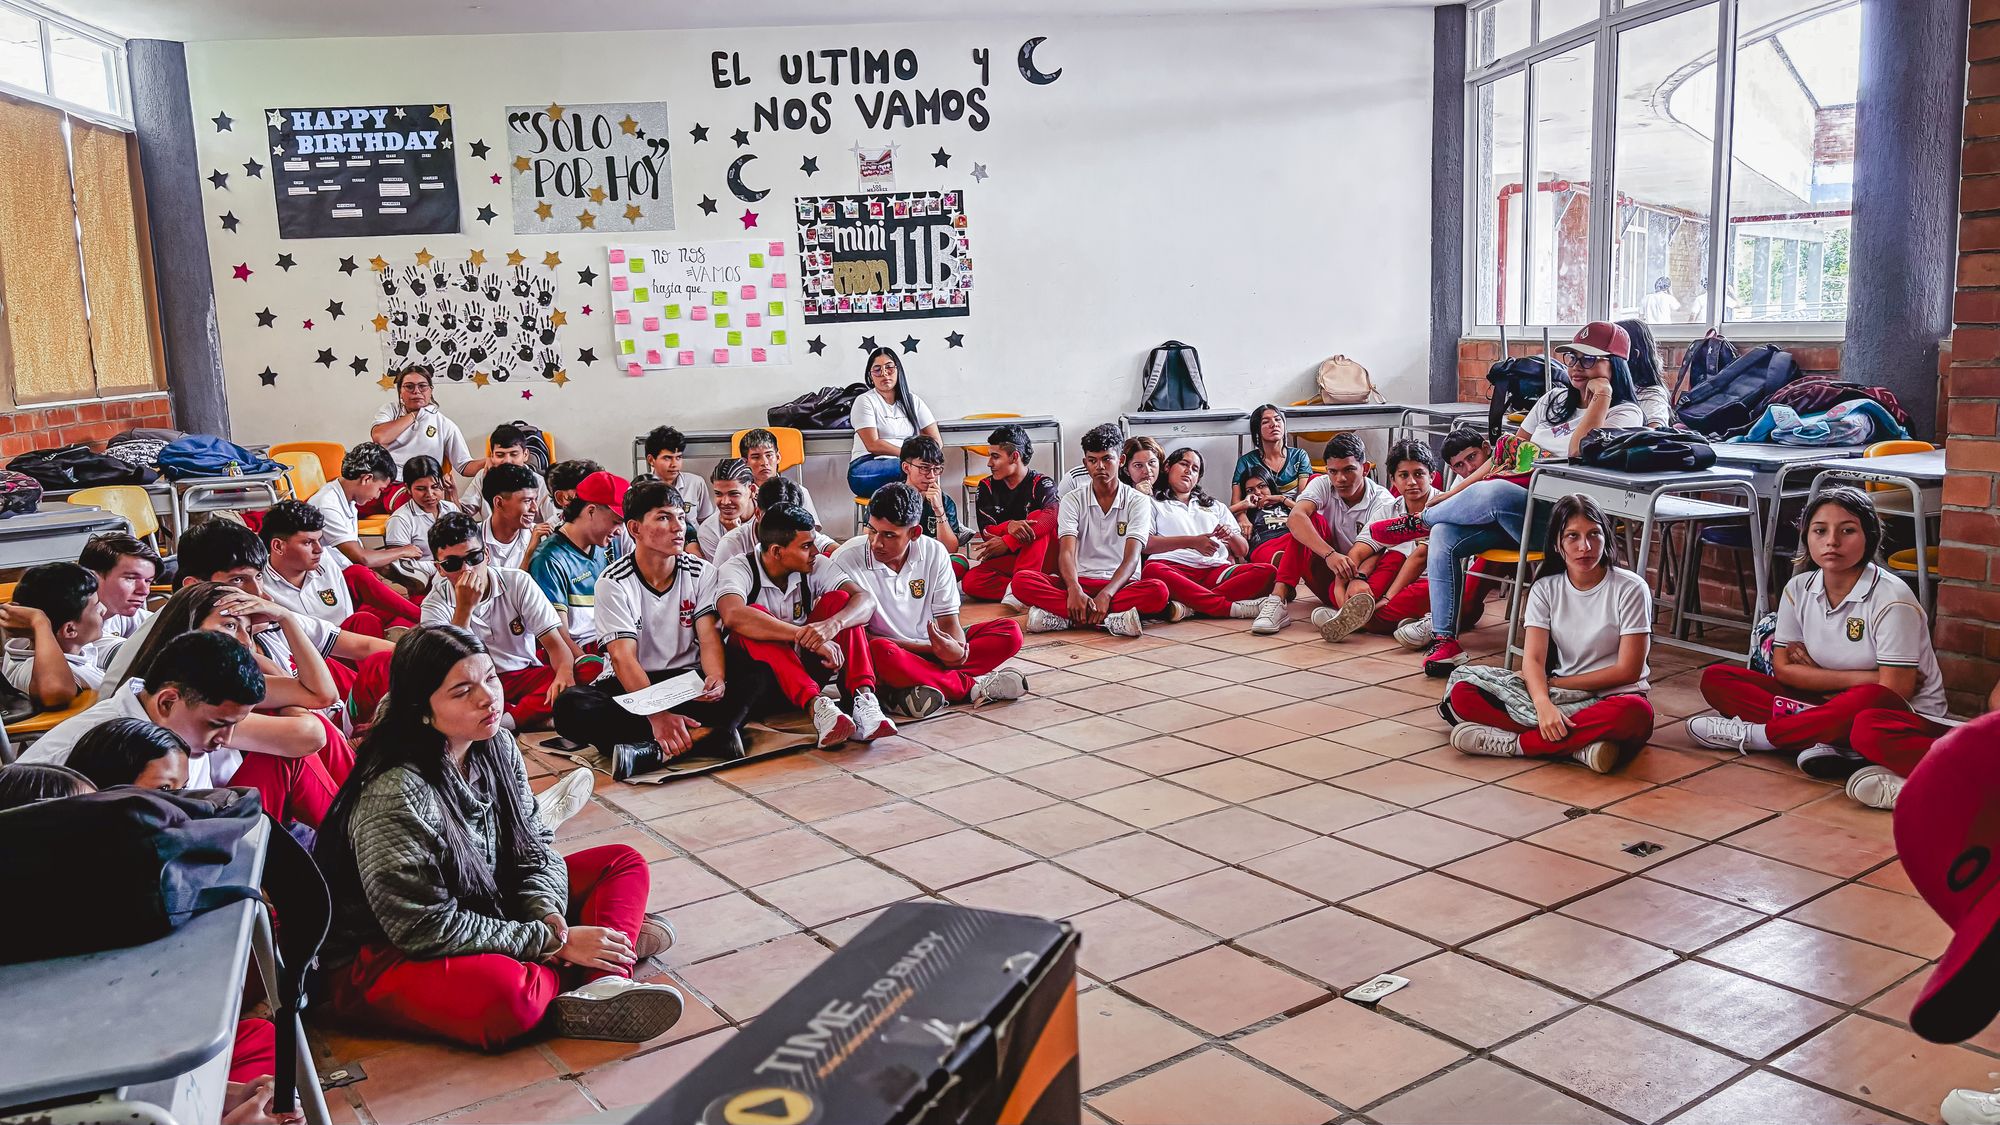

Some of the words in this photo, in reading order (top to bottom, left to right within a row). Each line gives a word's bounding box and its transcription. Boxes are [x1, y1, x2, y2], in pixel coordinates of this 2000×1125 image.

[711, 51, 751, 88] EL
[780, 47, 918, 86] ULTIMO
[291, 109, 389, 131] HAPPY
[754, 92, 832, 135] NOS
[854, 87, 990, 132] VAMOS
[295, 130, 439, 154] BIRTHDAY
[534, 157, 594, 198] POR
[834, 220, 886, 253] mini
[889, 224, 961, 290] 11B
[691, 265, 741, 282] VAMOS
[753, 999, 868, 1074] TIME
[862, 978, 897, 999] TO
